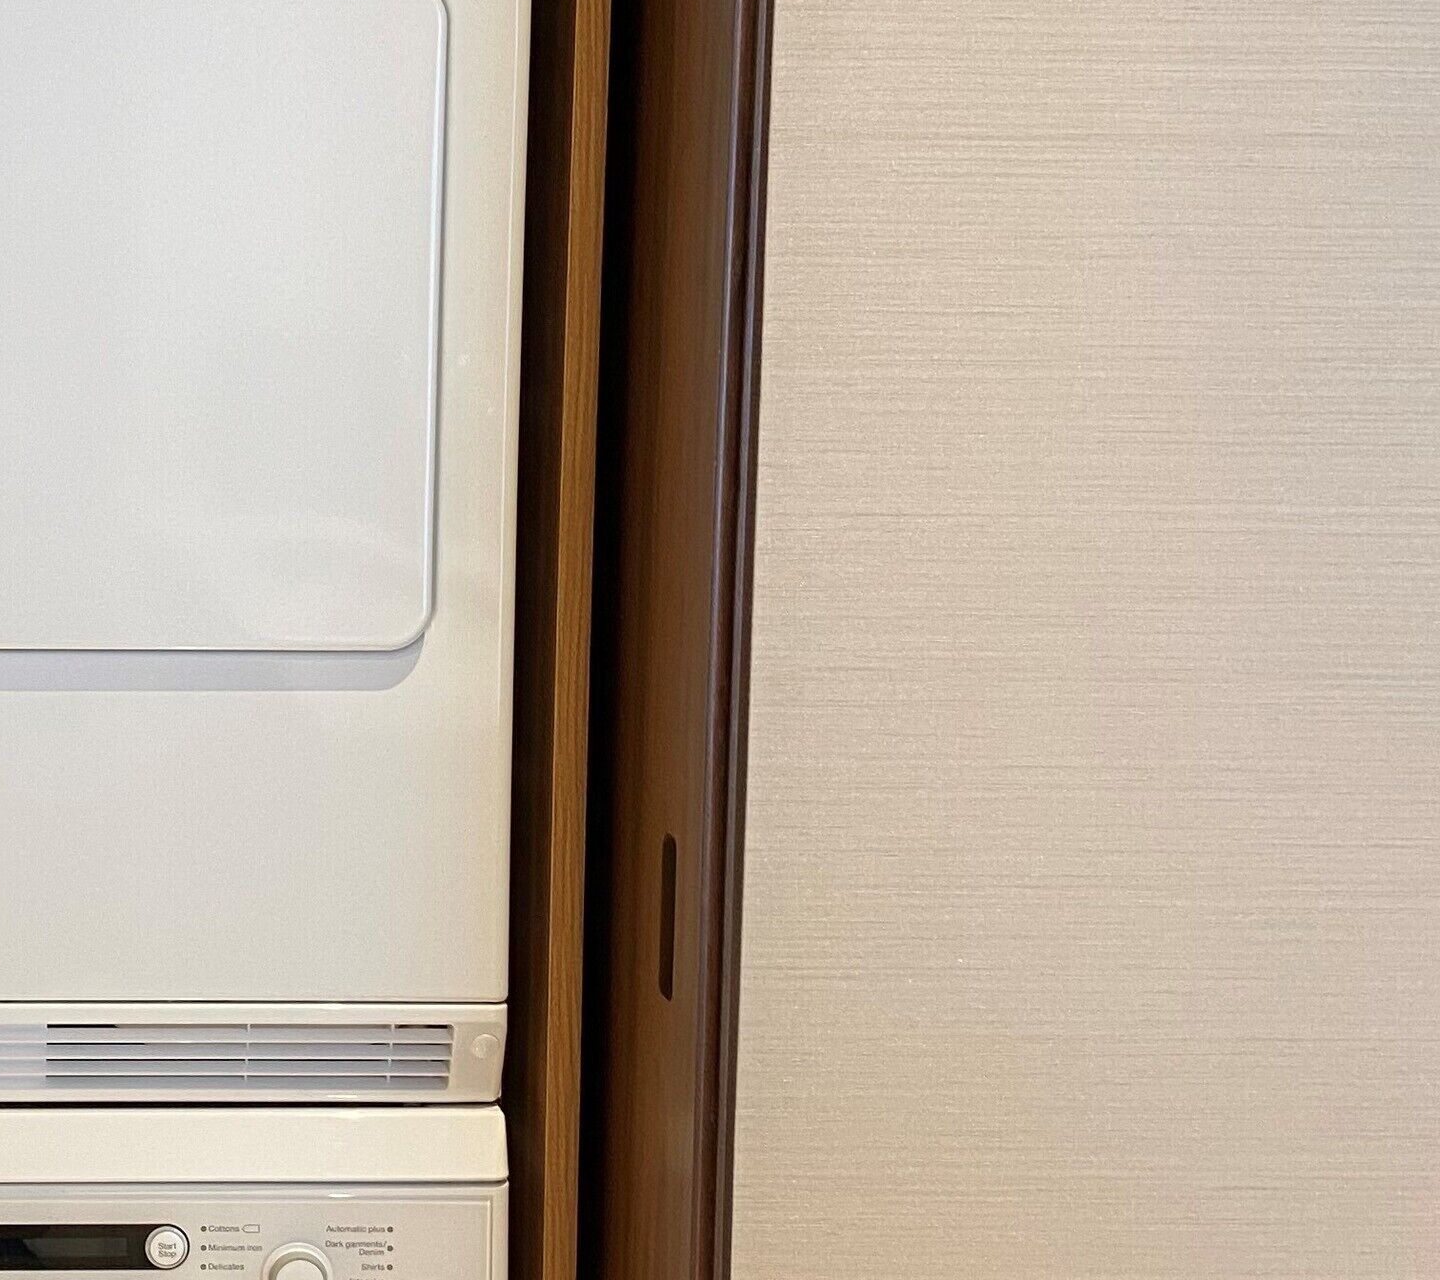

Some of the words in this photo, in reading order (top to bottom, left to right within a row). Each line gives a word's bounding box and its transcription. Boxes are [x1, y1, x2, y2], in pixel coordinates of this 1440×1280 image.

[325, 1225, 367, 1234] Automatic
[157, 1242, 177, 1251] Start
[158, 1250, 177, 1259] Stop
